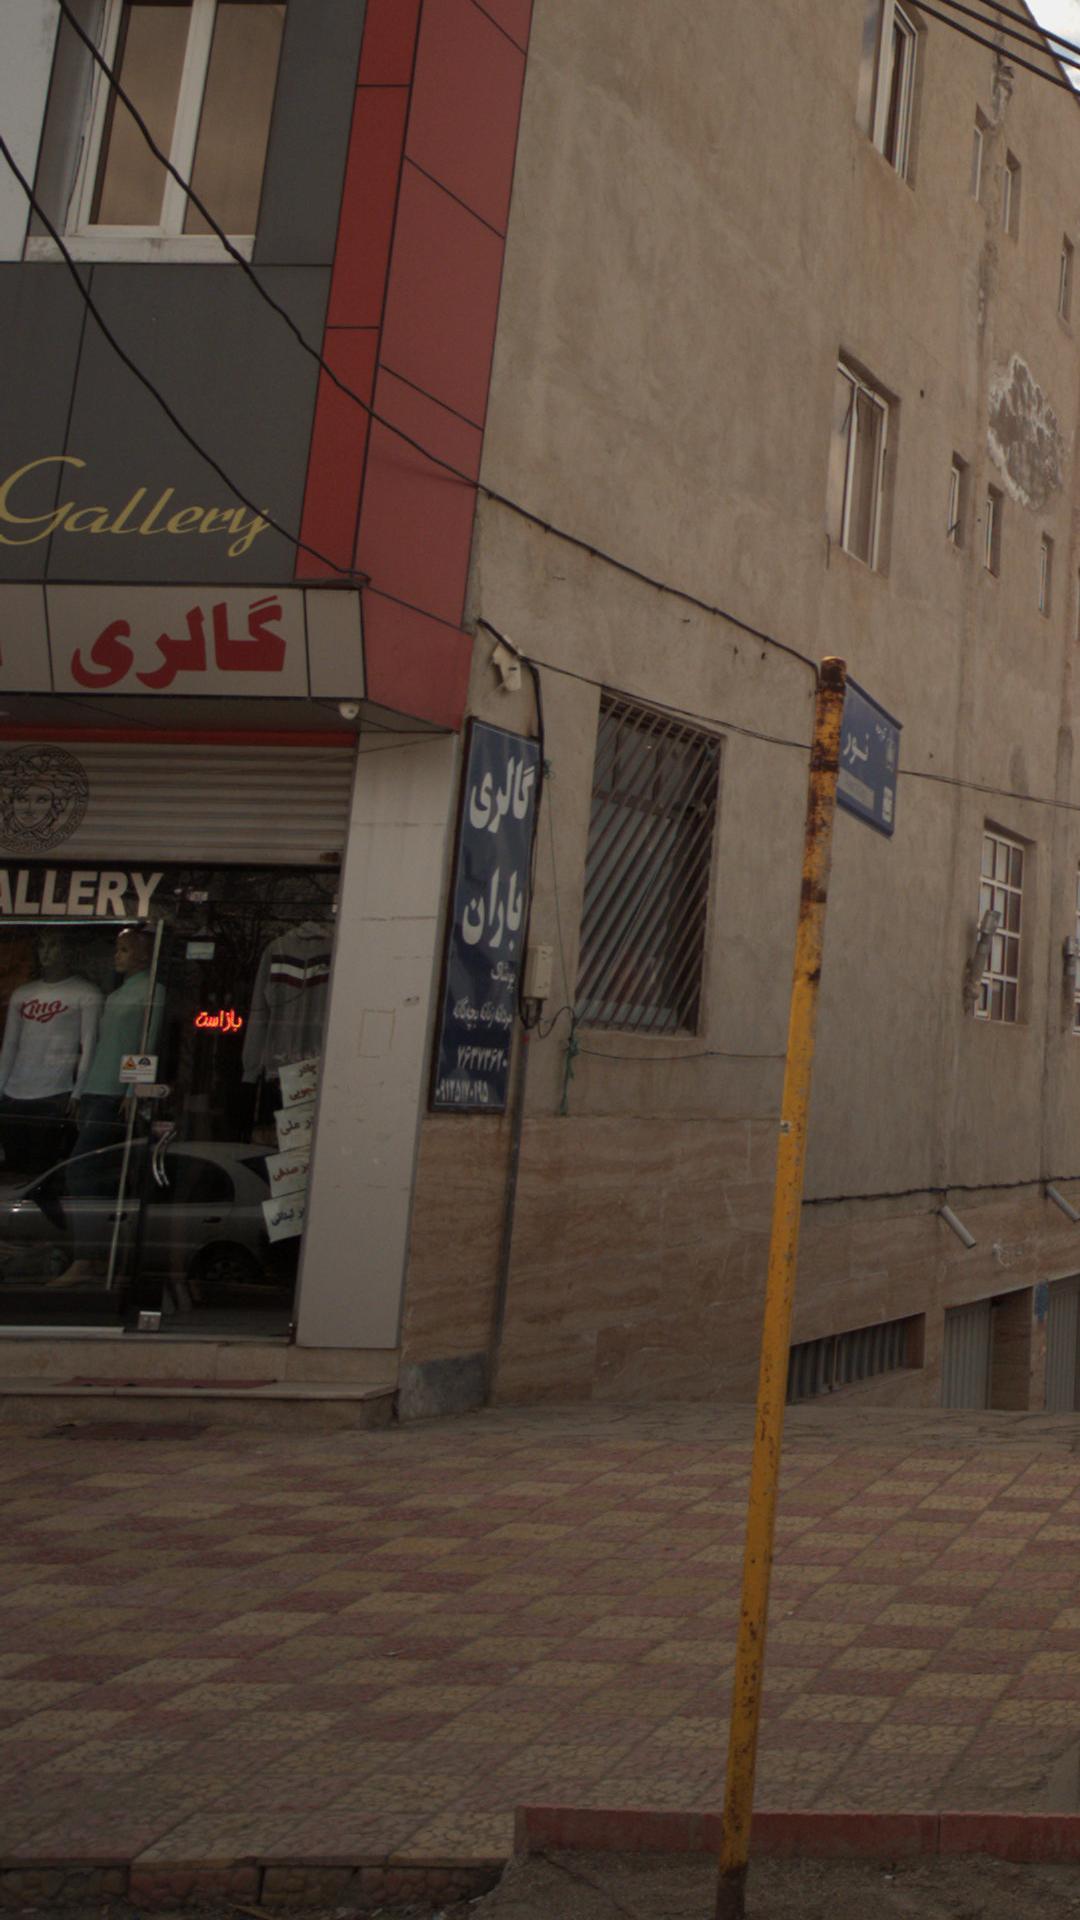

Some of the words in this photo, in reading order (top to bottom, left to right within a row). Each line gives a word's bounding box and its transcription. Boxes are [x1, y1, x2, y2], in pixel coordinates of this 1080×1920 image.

[0, 455, 271, 557] Gallery
[71, 594, 287, 689] گالری
[470, 757, 535, 834] گالری
[462, 866, 522, 951] باران
